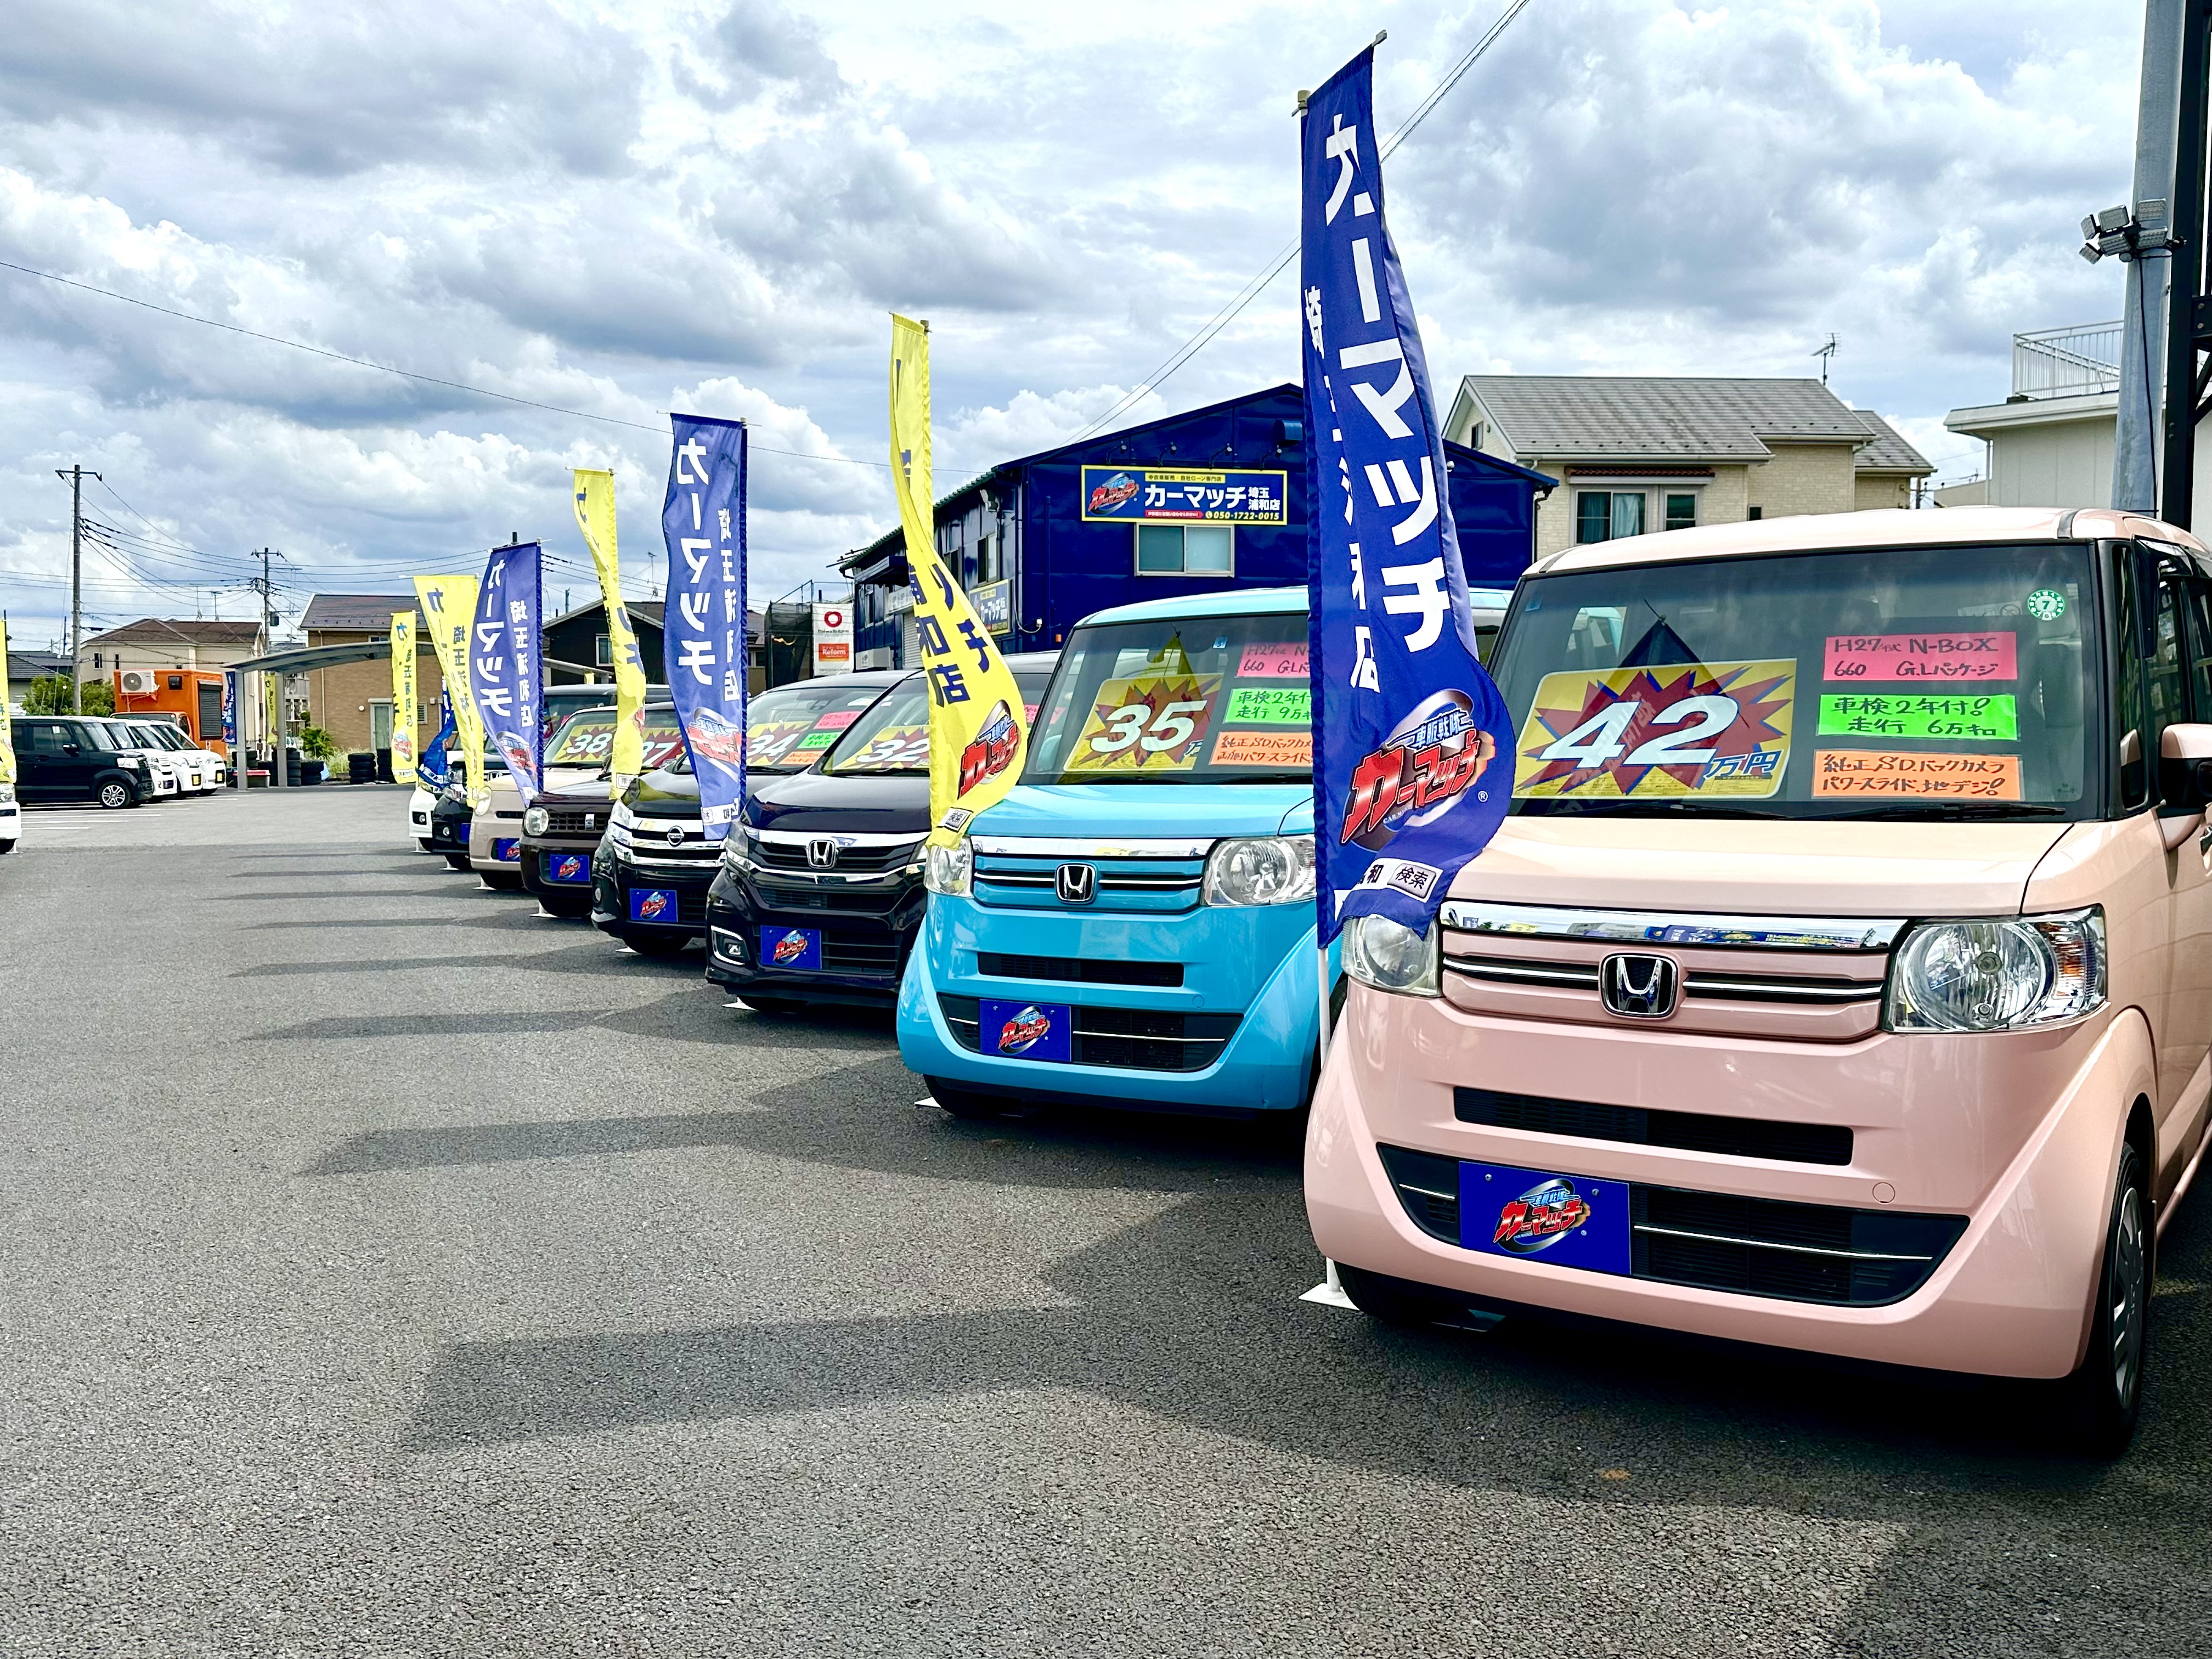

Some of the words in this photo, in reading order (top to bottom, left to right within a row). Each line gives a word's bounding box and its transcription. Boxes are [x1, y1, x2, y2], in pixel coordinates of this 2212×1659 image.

[1325, 113, 1450, 652] カーマッチ
[1145, 484, 1246, 509] カーマッチ
[1248, 487, 1269, 498] 埼玉
[1214, 511, 1279, 520] 050-1722-0015
[1248, 499, 1280, 511] 浦和店
[1909, 637, 1999, 654] N-BOX
[1243, 659, 1265, 672] 660
[1834, 661, 1867, 676] 660
[1235, 705, 1270, 719] 走行
[1847, 715, 1906, 733] 走行
[1090, 700, 1207, 753] 35
[1539, 694, 1739, 769] 42
[566, 733, 612, 754] 38
[747, 733, 799, 757] 34
[856, 739, 930, 763] 32
[1703, 749, 1784, 780] 万円
[1342, 728, 1480, 844] カーマッチ
[1395, 866, 1429, 890] 検索
[1493, 1199, 1583, 1243] カーマッチ
